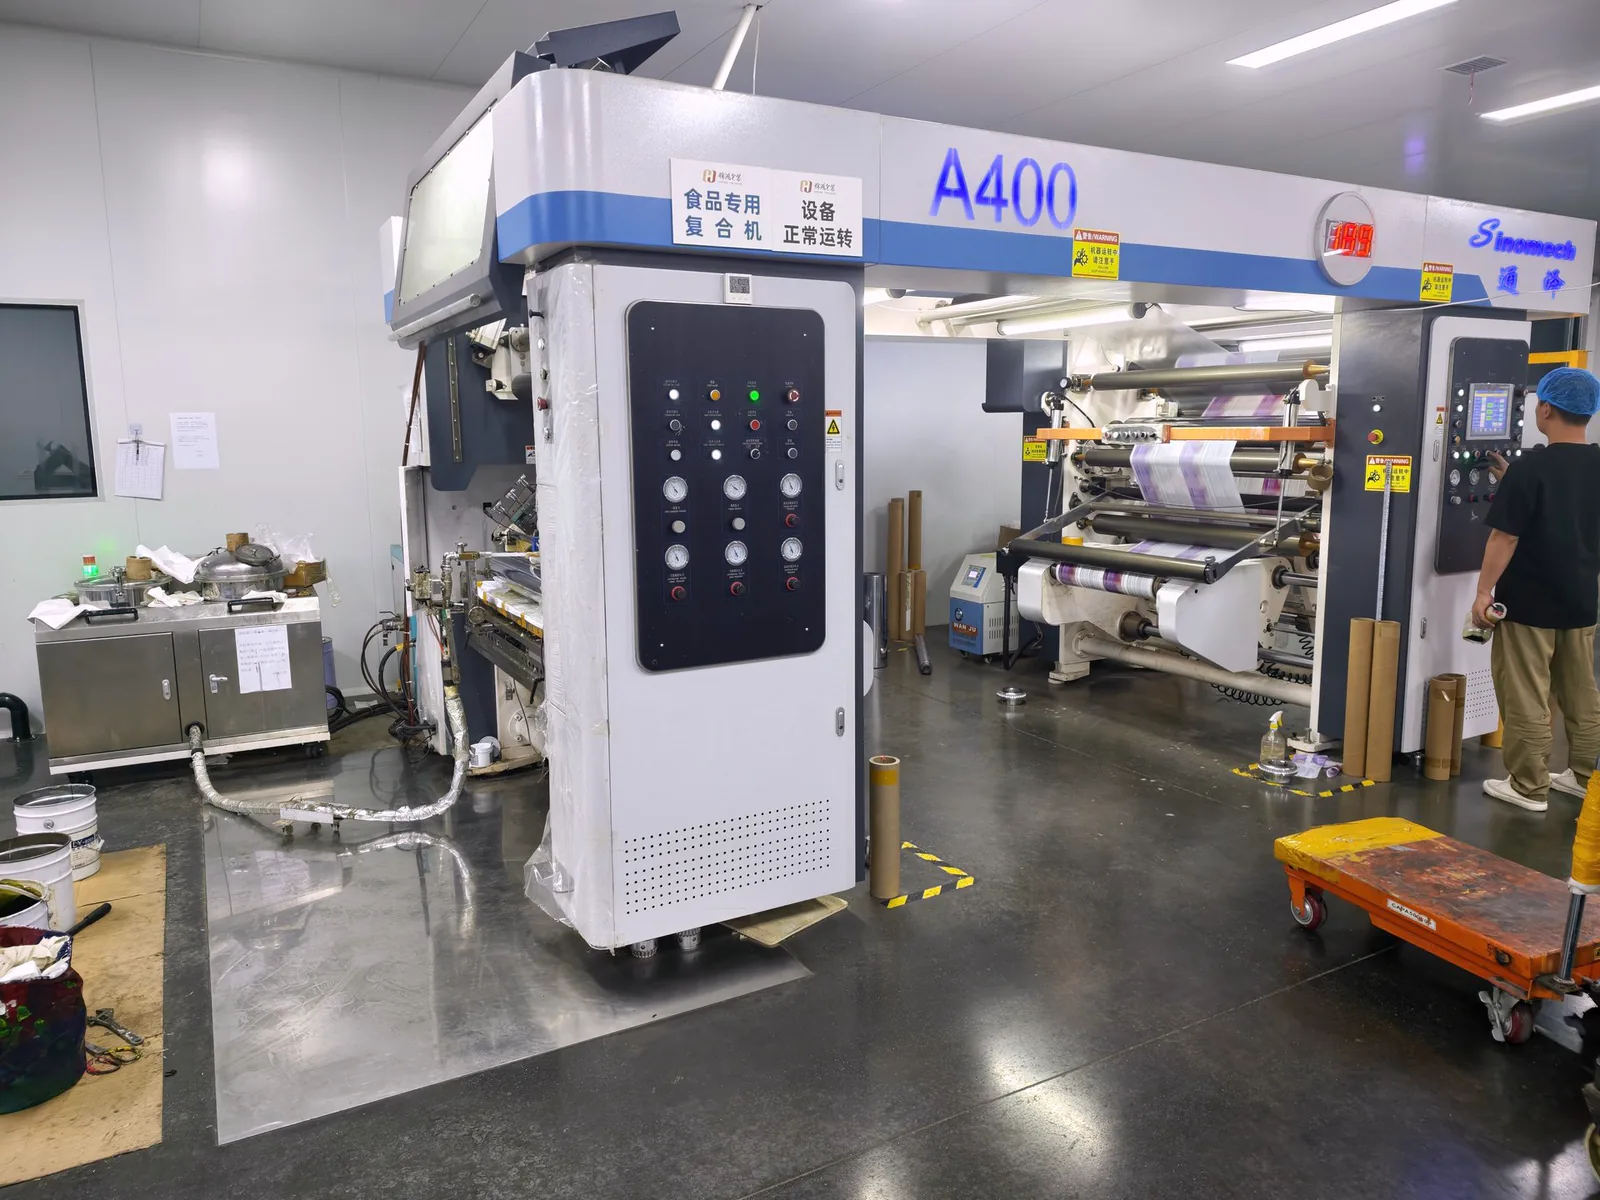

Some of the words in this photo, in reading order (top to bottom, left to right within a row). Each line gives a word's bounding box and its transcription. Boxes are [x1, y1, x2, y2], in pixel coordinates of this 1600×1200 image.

[684, 188, 761, 216] 食品专用
[928, 147, 1078, 230] A400
[801, 200, 836, 222] 设备
[783, 224, 853, 249] 正常运转
[1469, 218, 1577, 262] Sinomech
